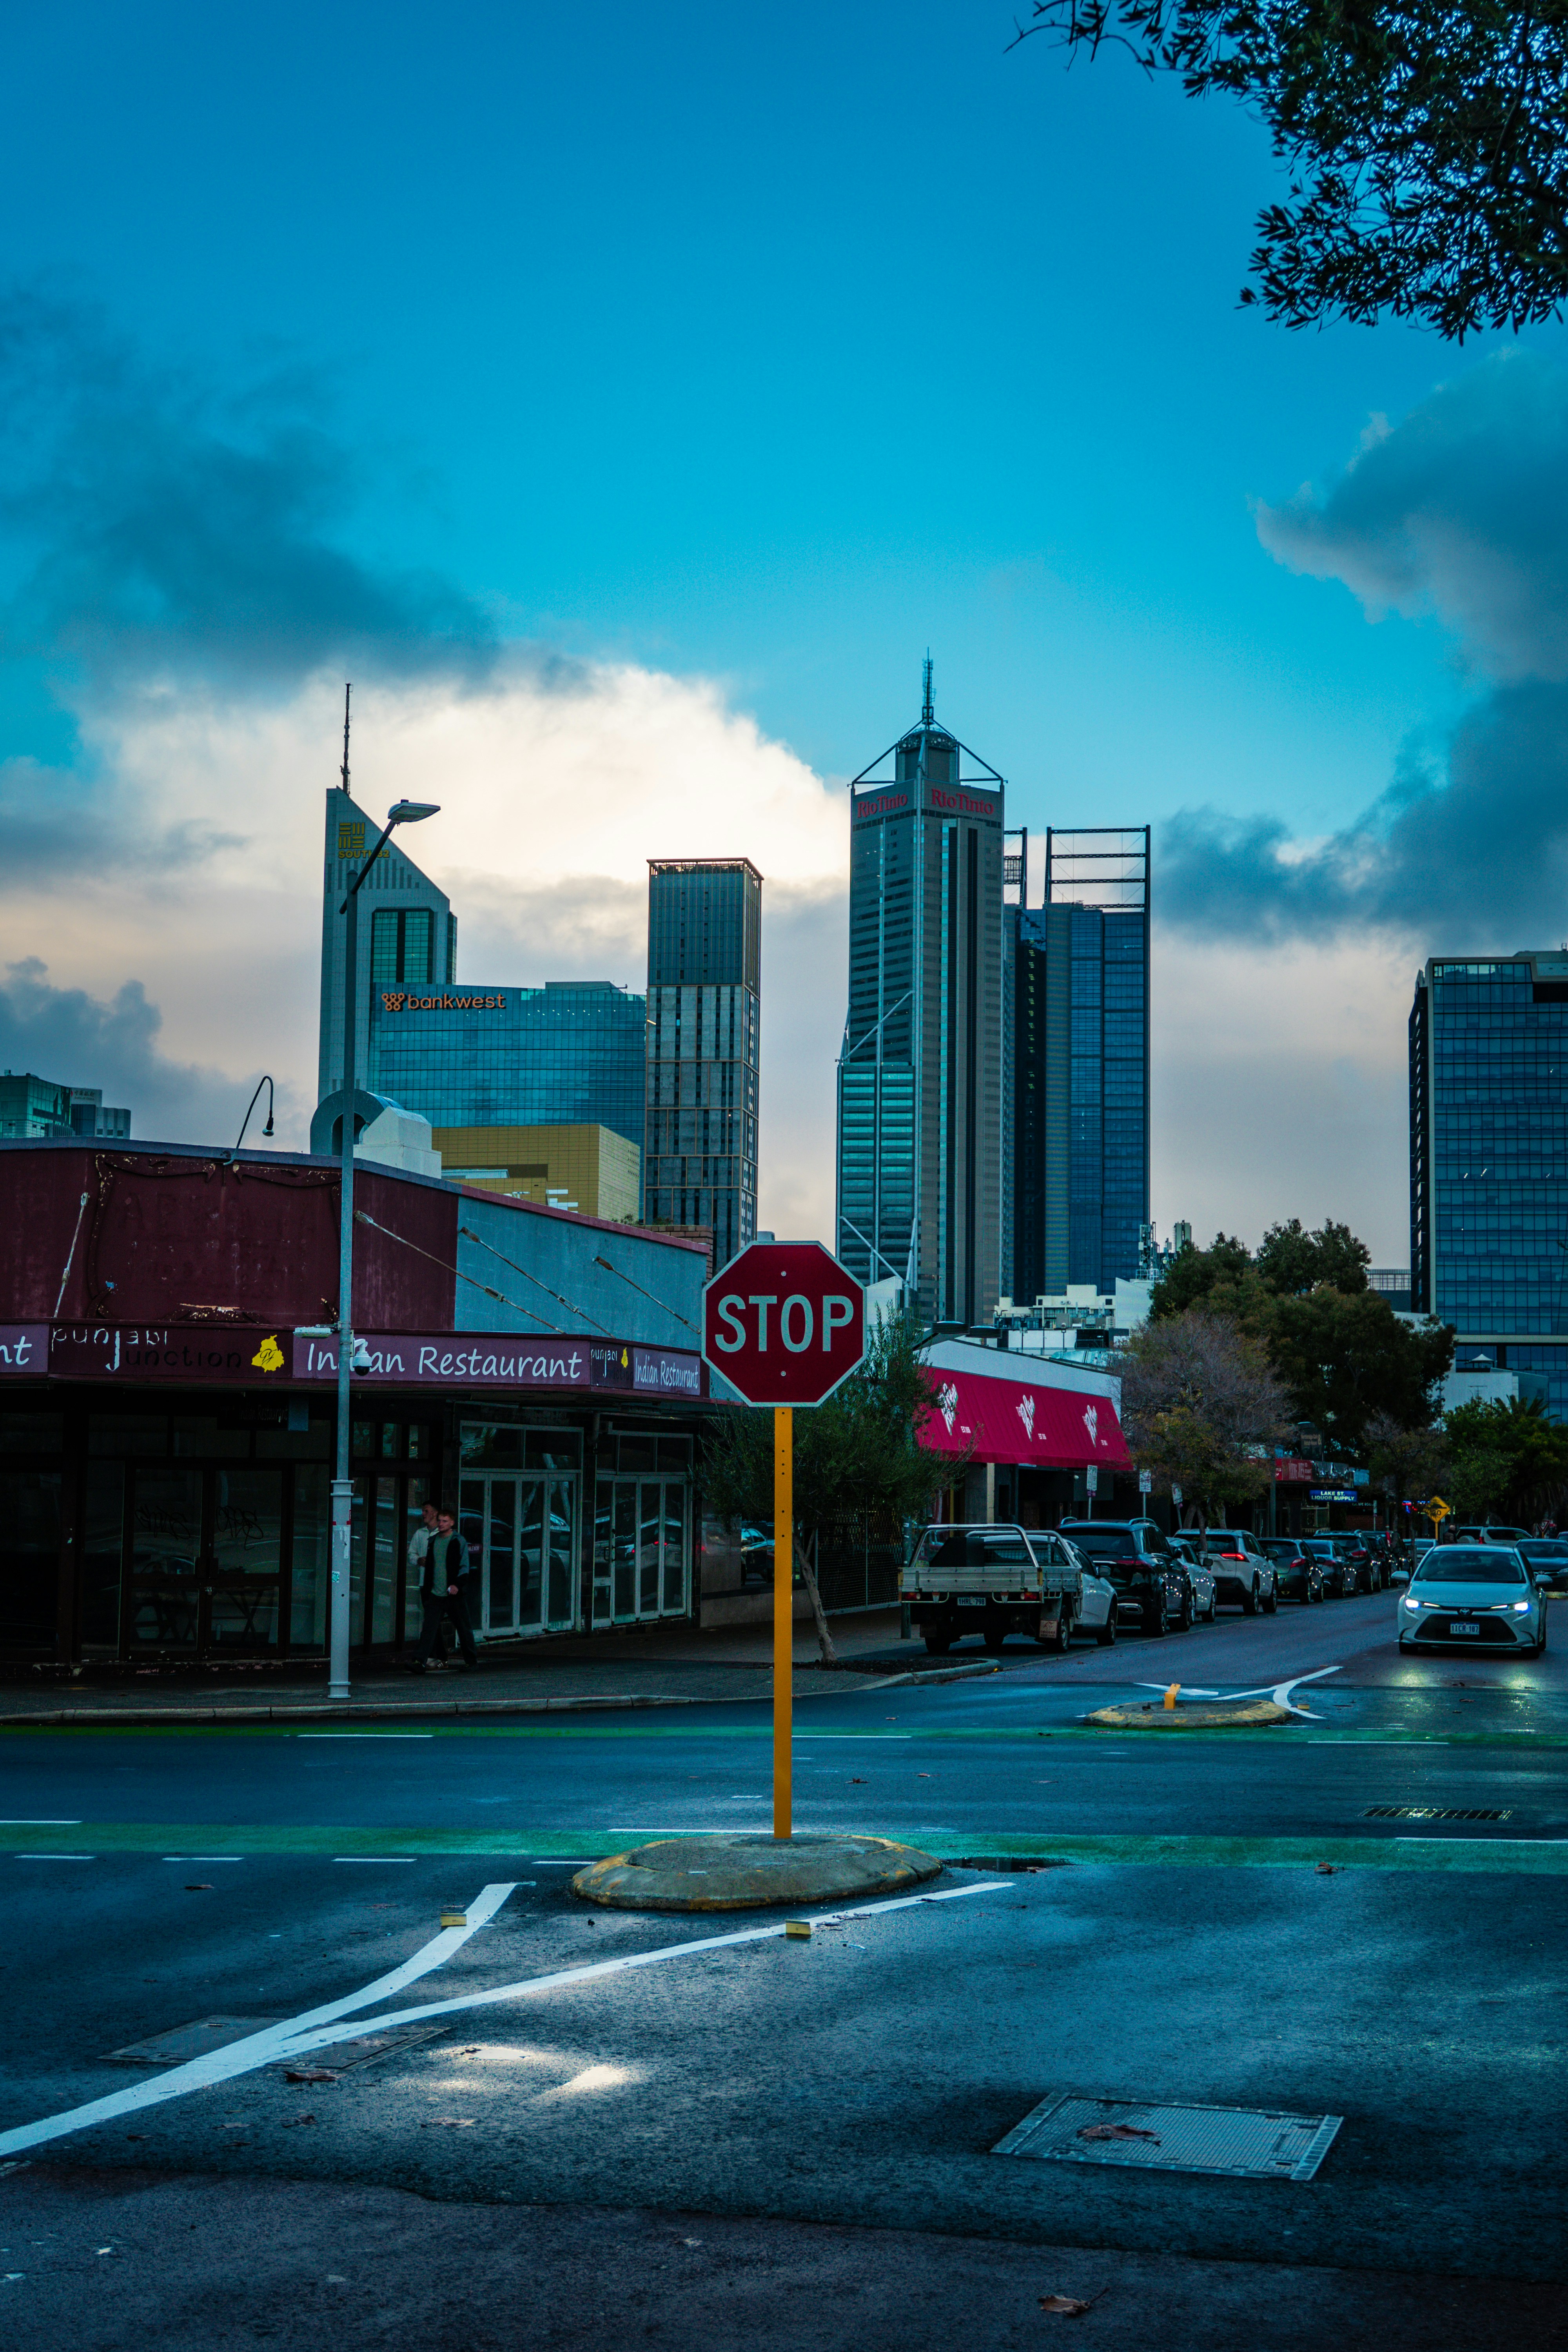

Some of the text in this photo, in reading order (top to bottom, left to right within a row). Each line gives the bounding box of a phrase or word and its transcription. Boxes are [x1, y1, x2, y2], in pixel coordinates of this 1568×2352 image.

[408, 993, 506, 1009] bankwest
[715, 1294, 854, 1353] STOP
[419, 1347, 582, 1379] Restaurant
[635, 1354, 699, 1389] Indian Restaurant
